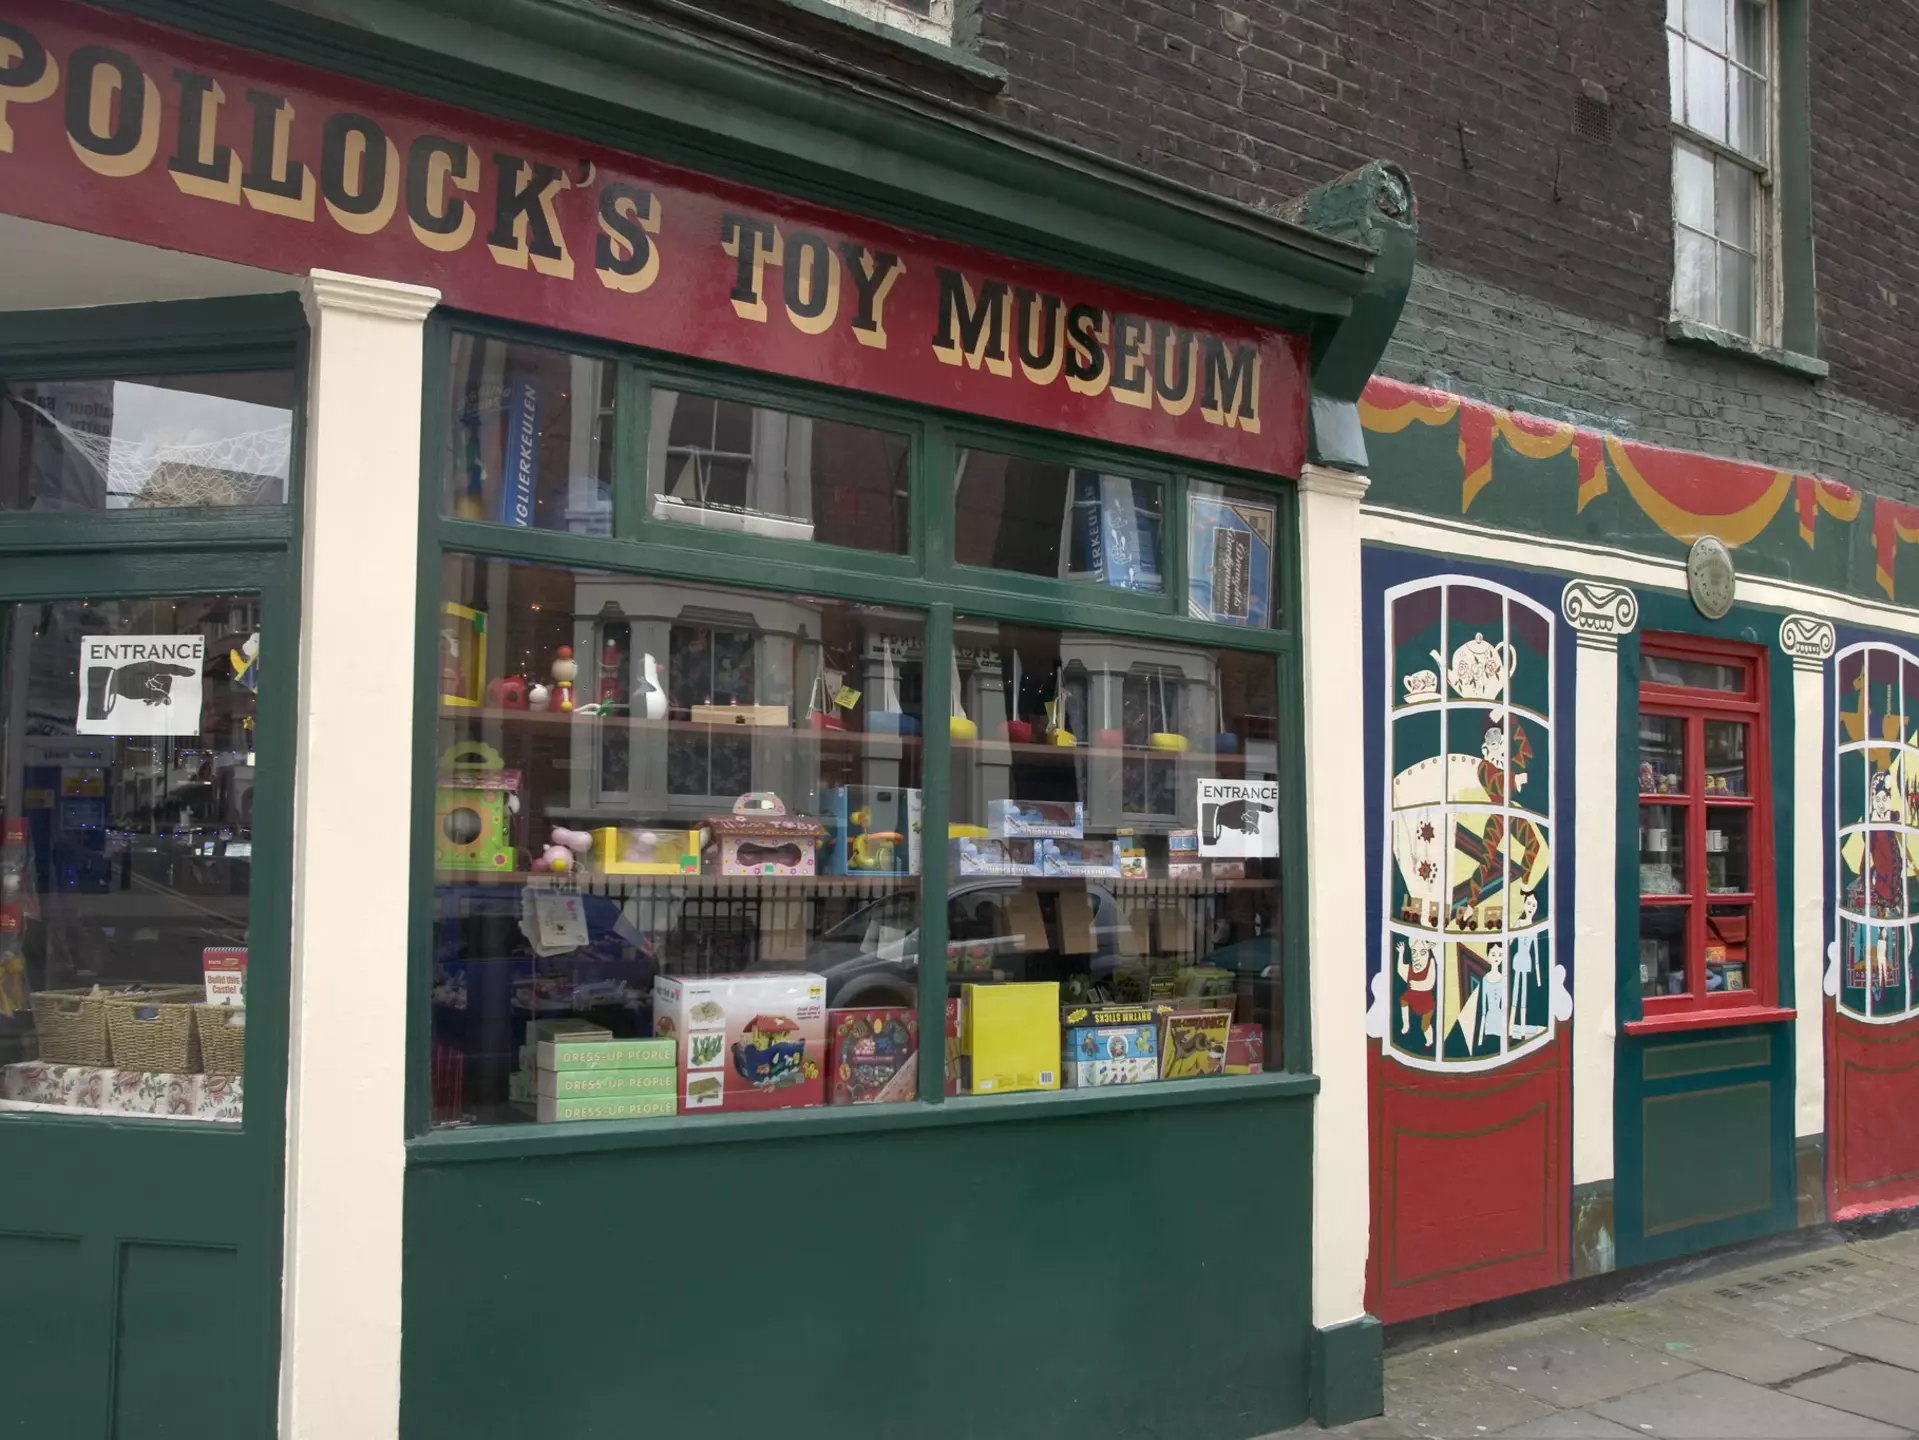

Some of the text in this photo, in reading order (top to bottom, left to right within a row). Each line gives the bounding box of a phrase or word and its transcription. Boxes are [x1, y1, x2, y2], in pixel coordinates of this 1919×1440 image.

[0, 21, 1261, 434] POLLOCK'S TOY MUSEUM
[90, 643, 202, 660] ENTRANCE
[1203, 785, 1278, 802] ENTRANCE
[1094, 1011, 1152, 1023] RHYTHM STICKS
[563, 1049, 672, 1063] DRESS-UP PEOPLE
[629, 1077, 672, 1088] PEOPLE
[565, 1102, 673, 1118] DRESS-UP PEOPLE
